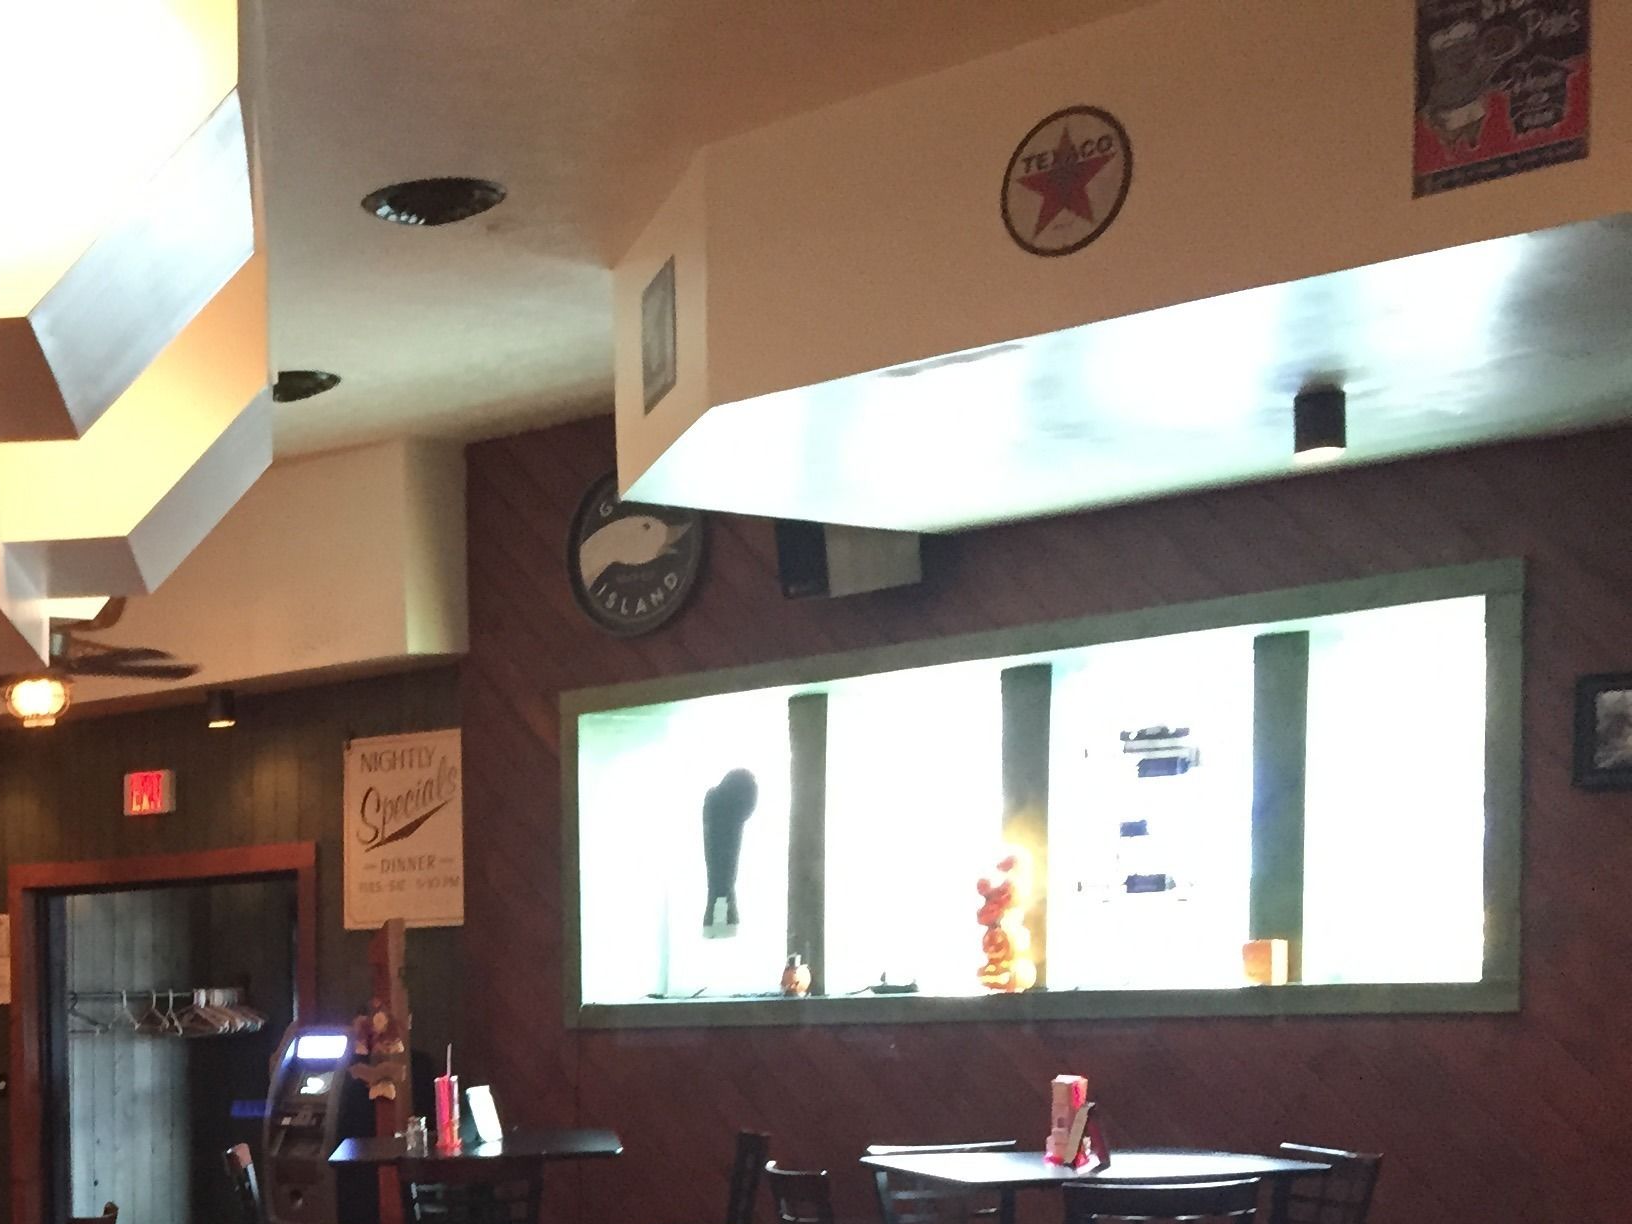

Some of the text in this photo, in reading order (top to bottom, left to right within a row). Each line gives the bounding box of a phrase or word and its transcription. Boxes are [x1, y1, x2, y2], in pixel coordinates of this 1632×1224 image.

[1021, 134, 1113, 174] TEXACO
[596, 572, 678, 615] ISLAND
[360, 747, 436, 773] NIGHTLY
[356, 755, 457, 845] Specials
[381, 855, 435, 874] DINNER
